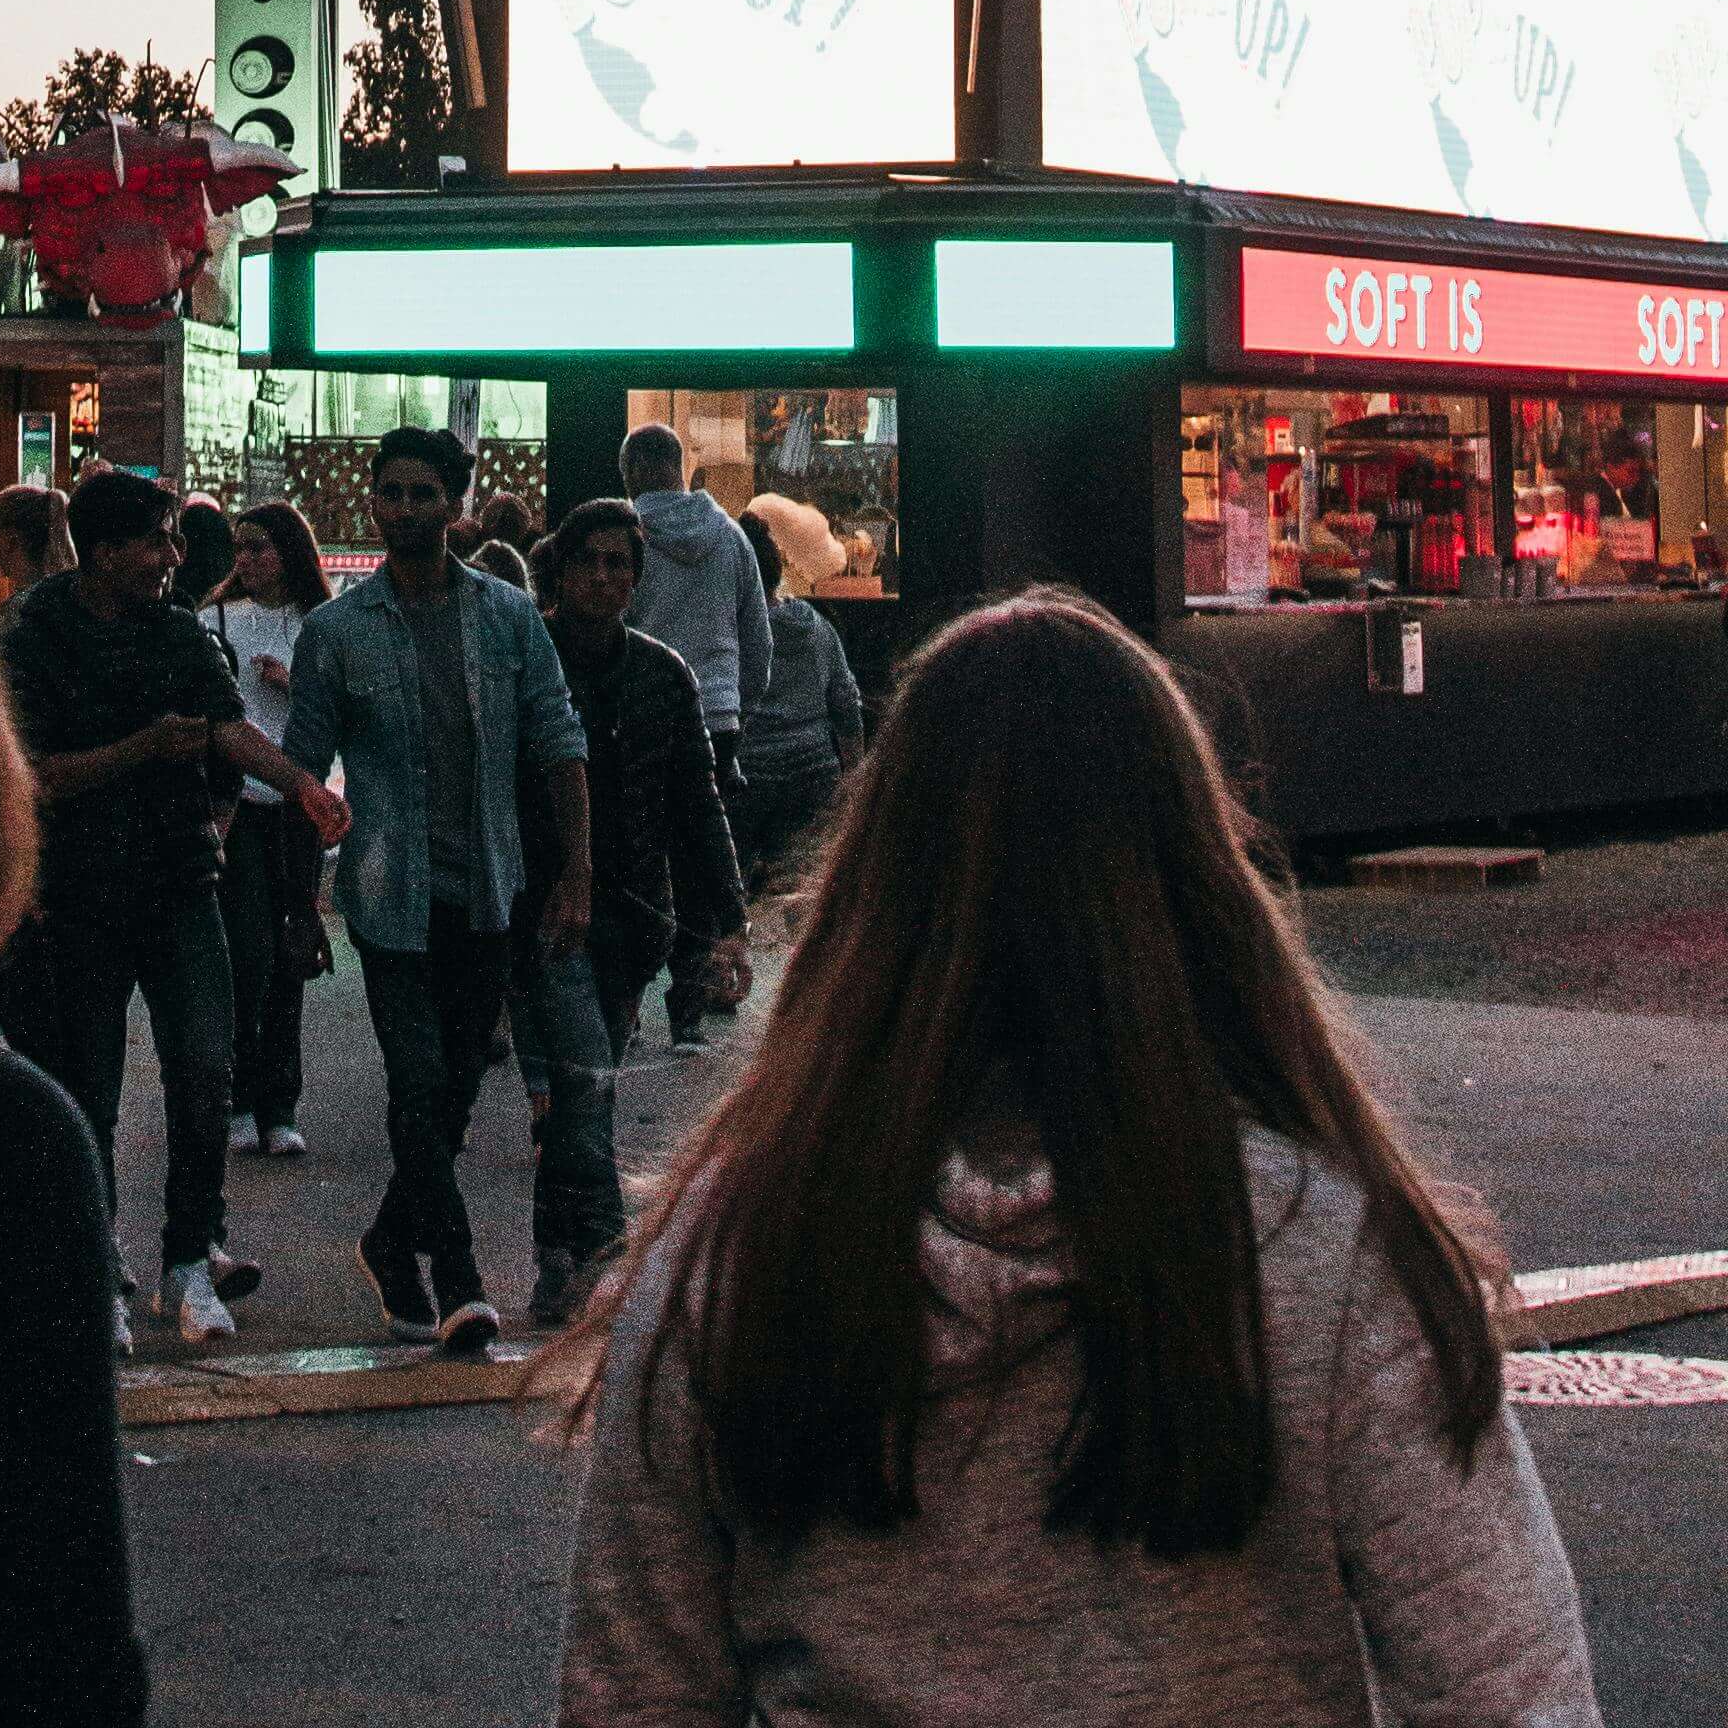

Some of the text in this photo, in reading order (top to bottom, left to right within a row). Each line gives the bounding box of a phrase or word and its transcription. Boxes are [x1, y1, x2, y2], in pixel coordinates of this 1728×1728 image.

[1513, 14, 1577, 148] UP!
[1325, 266, 1484, 354] SOFT IS
[1636, 294, 1726, 369] SOFT
